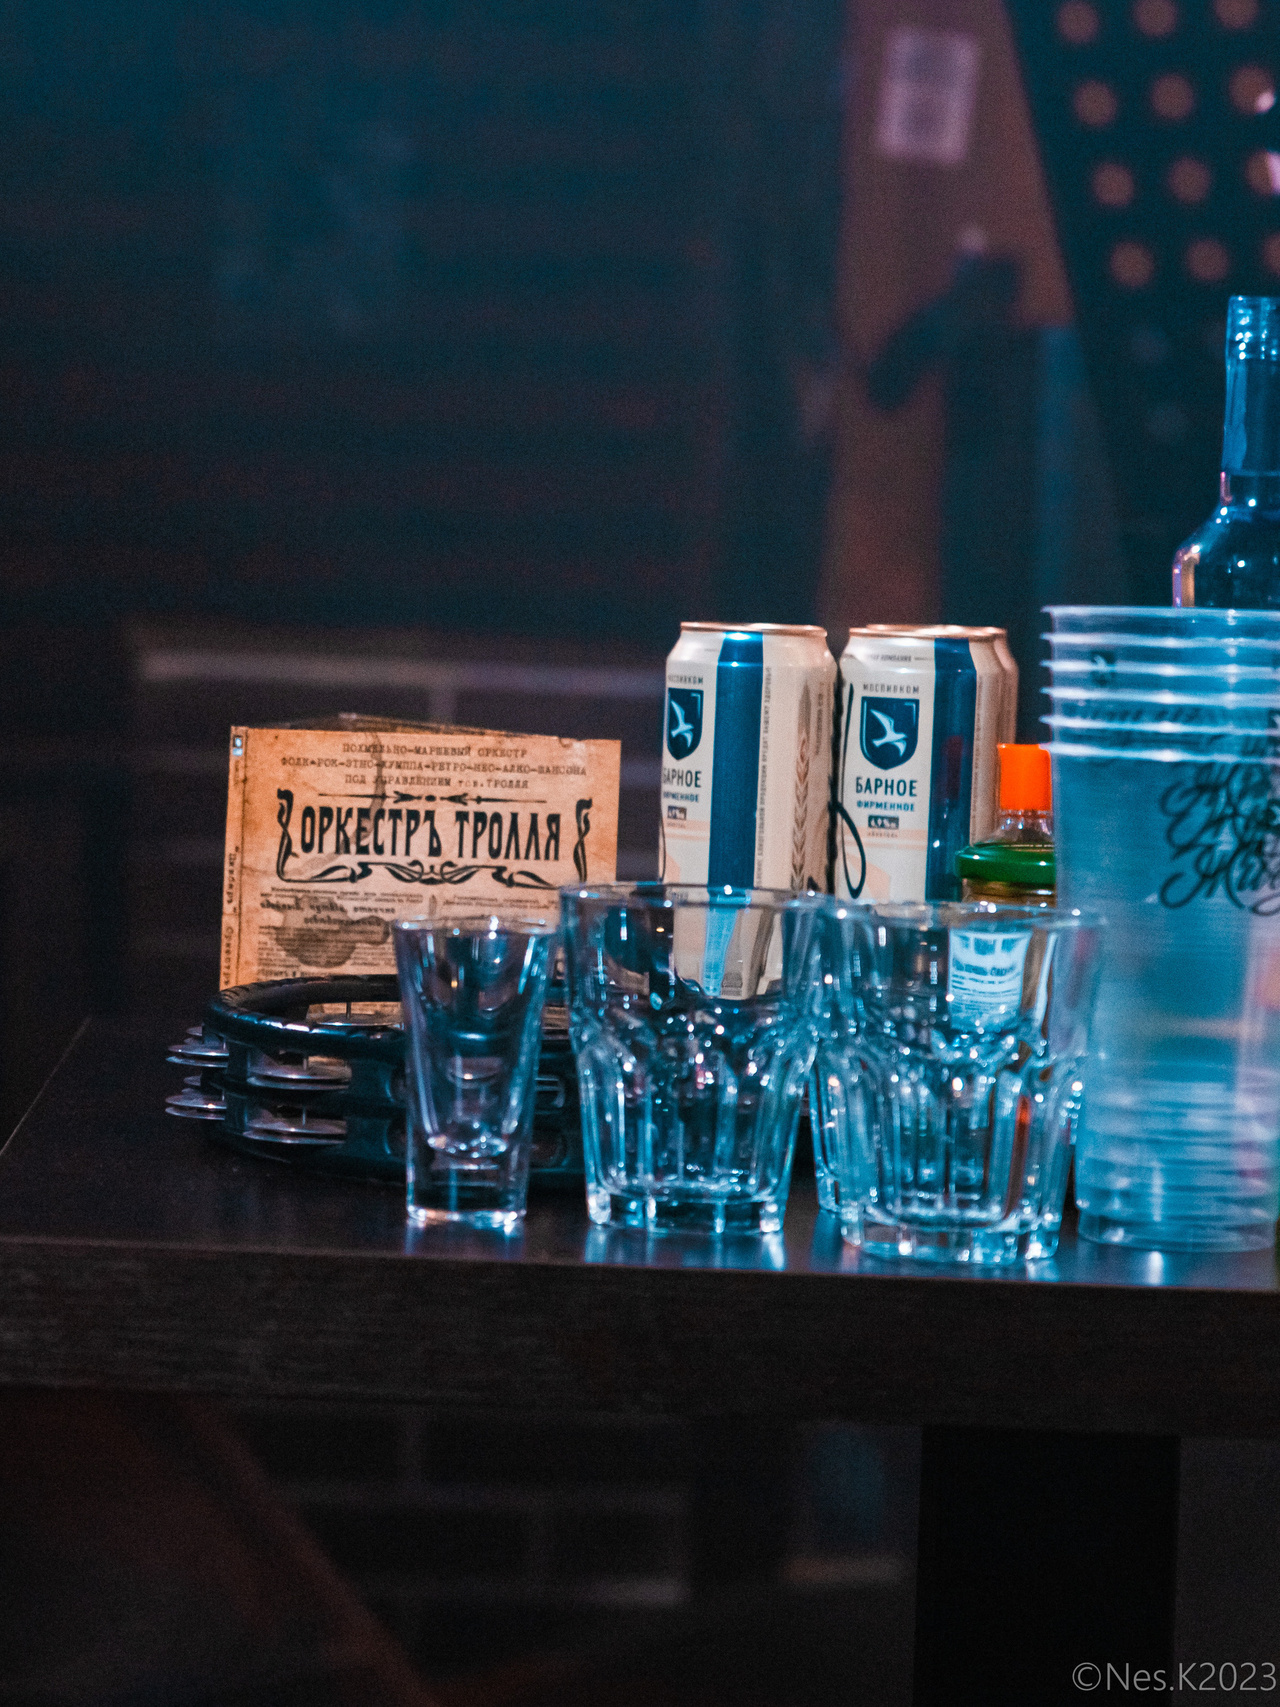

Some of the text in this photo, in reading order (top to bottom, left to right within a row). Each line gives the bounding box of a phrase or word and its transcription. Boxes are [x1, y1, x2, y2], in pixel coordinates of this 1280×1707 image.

[477, 747, 528, 759] ОРКЕСТР
[344, 774, 367, 785] ПОД
[856, 776, 918, 797] БАРНОЕ
[856, 800, 915, 812] ФИРМЕННОЕ
[300, 805, 562, 861] ОРКЕСТРЪ ТРОЛЛЯ
